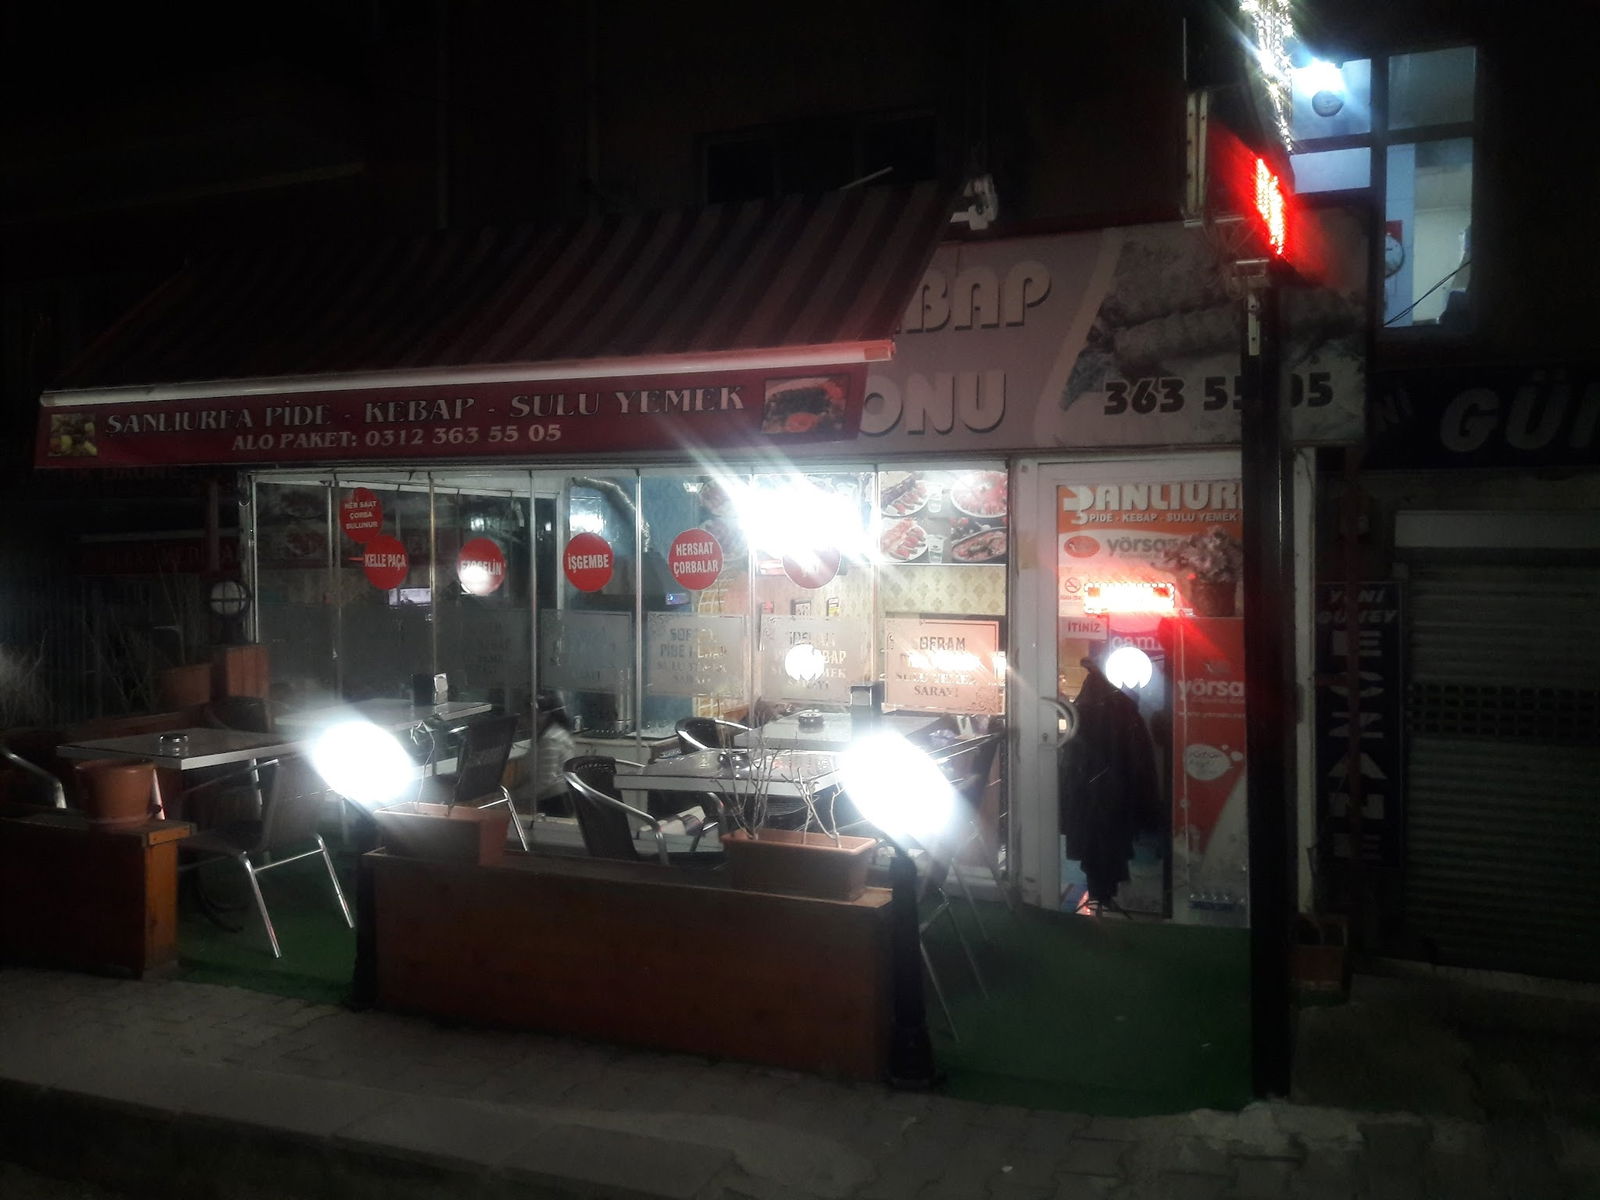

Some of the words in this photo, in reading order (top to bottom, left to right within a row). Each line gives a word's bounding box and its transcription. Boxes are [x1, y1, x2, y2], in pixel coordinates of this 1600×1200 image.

[897, 260, 1052, 334] BAP
[265, 400, 332, 428] PİDE
[365, 398, 475, 424] KEBAP
[511, 392, 601, 418] SULU
[615, 385, 745, 416] YEMEK
[1103, 377, 1185, 415] 363
[232, 434, 275, 451] ALO
[279, 431, 357, 449] PAKET:
[365, 428, 424, 448] 0312
[433, 426, 479, 445] 363
[487, 424, 519, 442] 55
[529, 423, 562, 442] 05
[1063, 482, 1243, 526] ŞANLIUR
[346, 521, 378, 530] BULUNUR
[1122, 511, 1157, 523] KEBAP
[1167, 511, 1194, 523] SULU
[1200, 510, 1237, 522] YEMEK
[676, 542, 713, 556] HERSAAT
[364, 553, 387, 568] KELLE
[388, 553, 407, 571] PAÇA
[673, 560, 719, 577] ÇORBALAR
